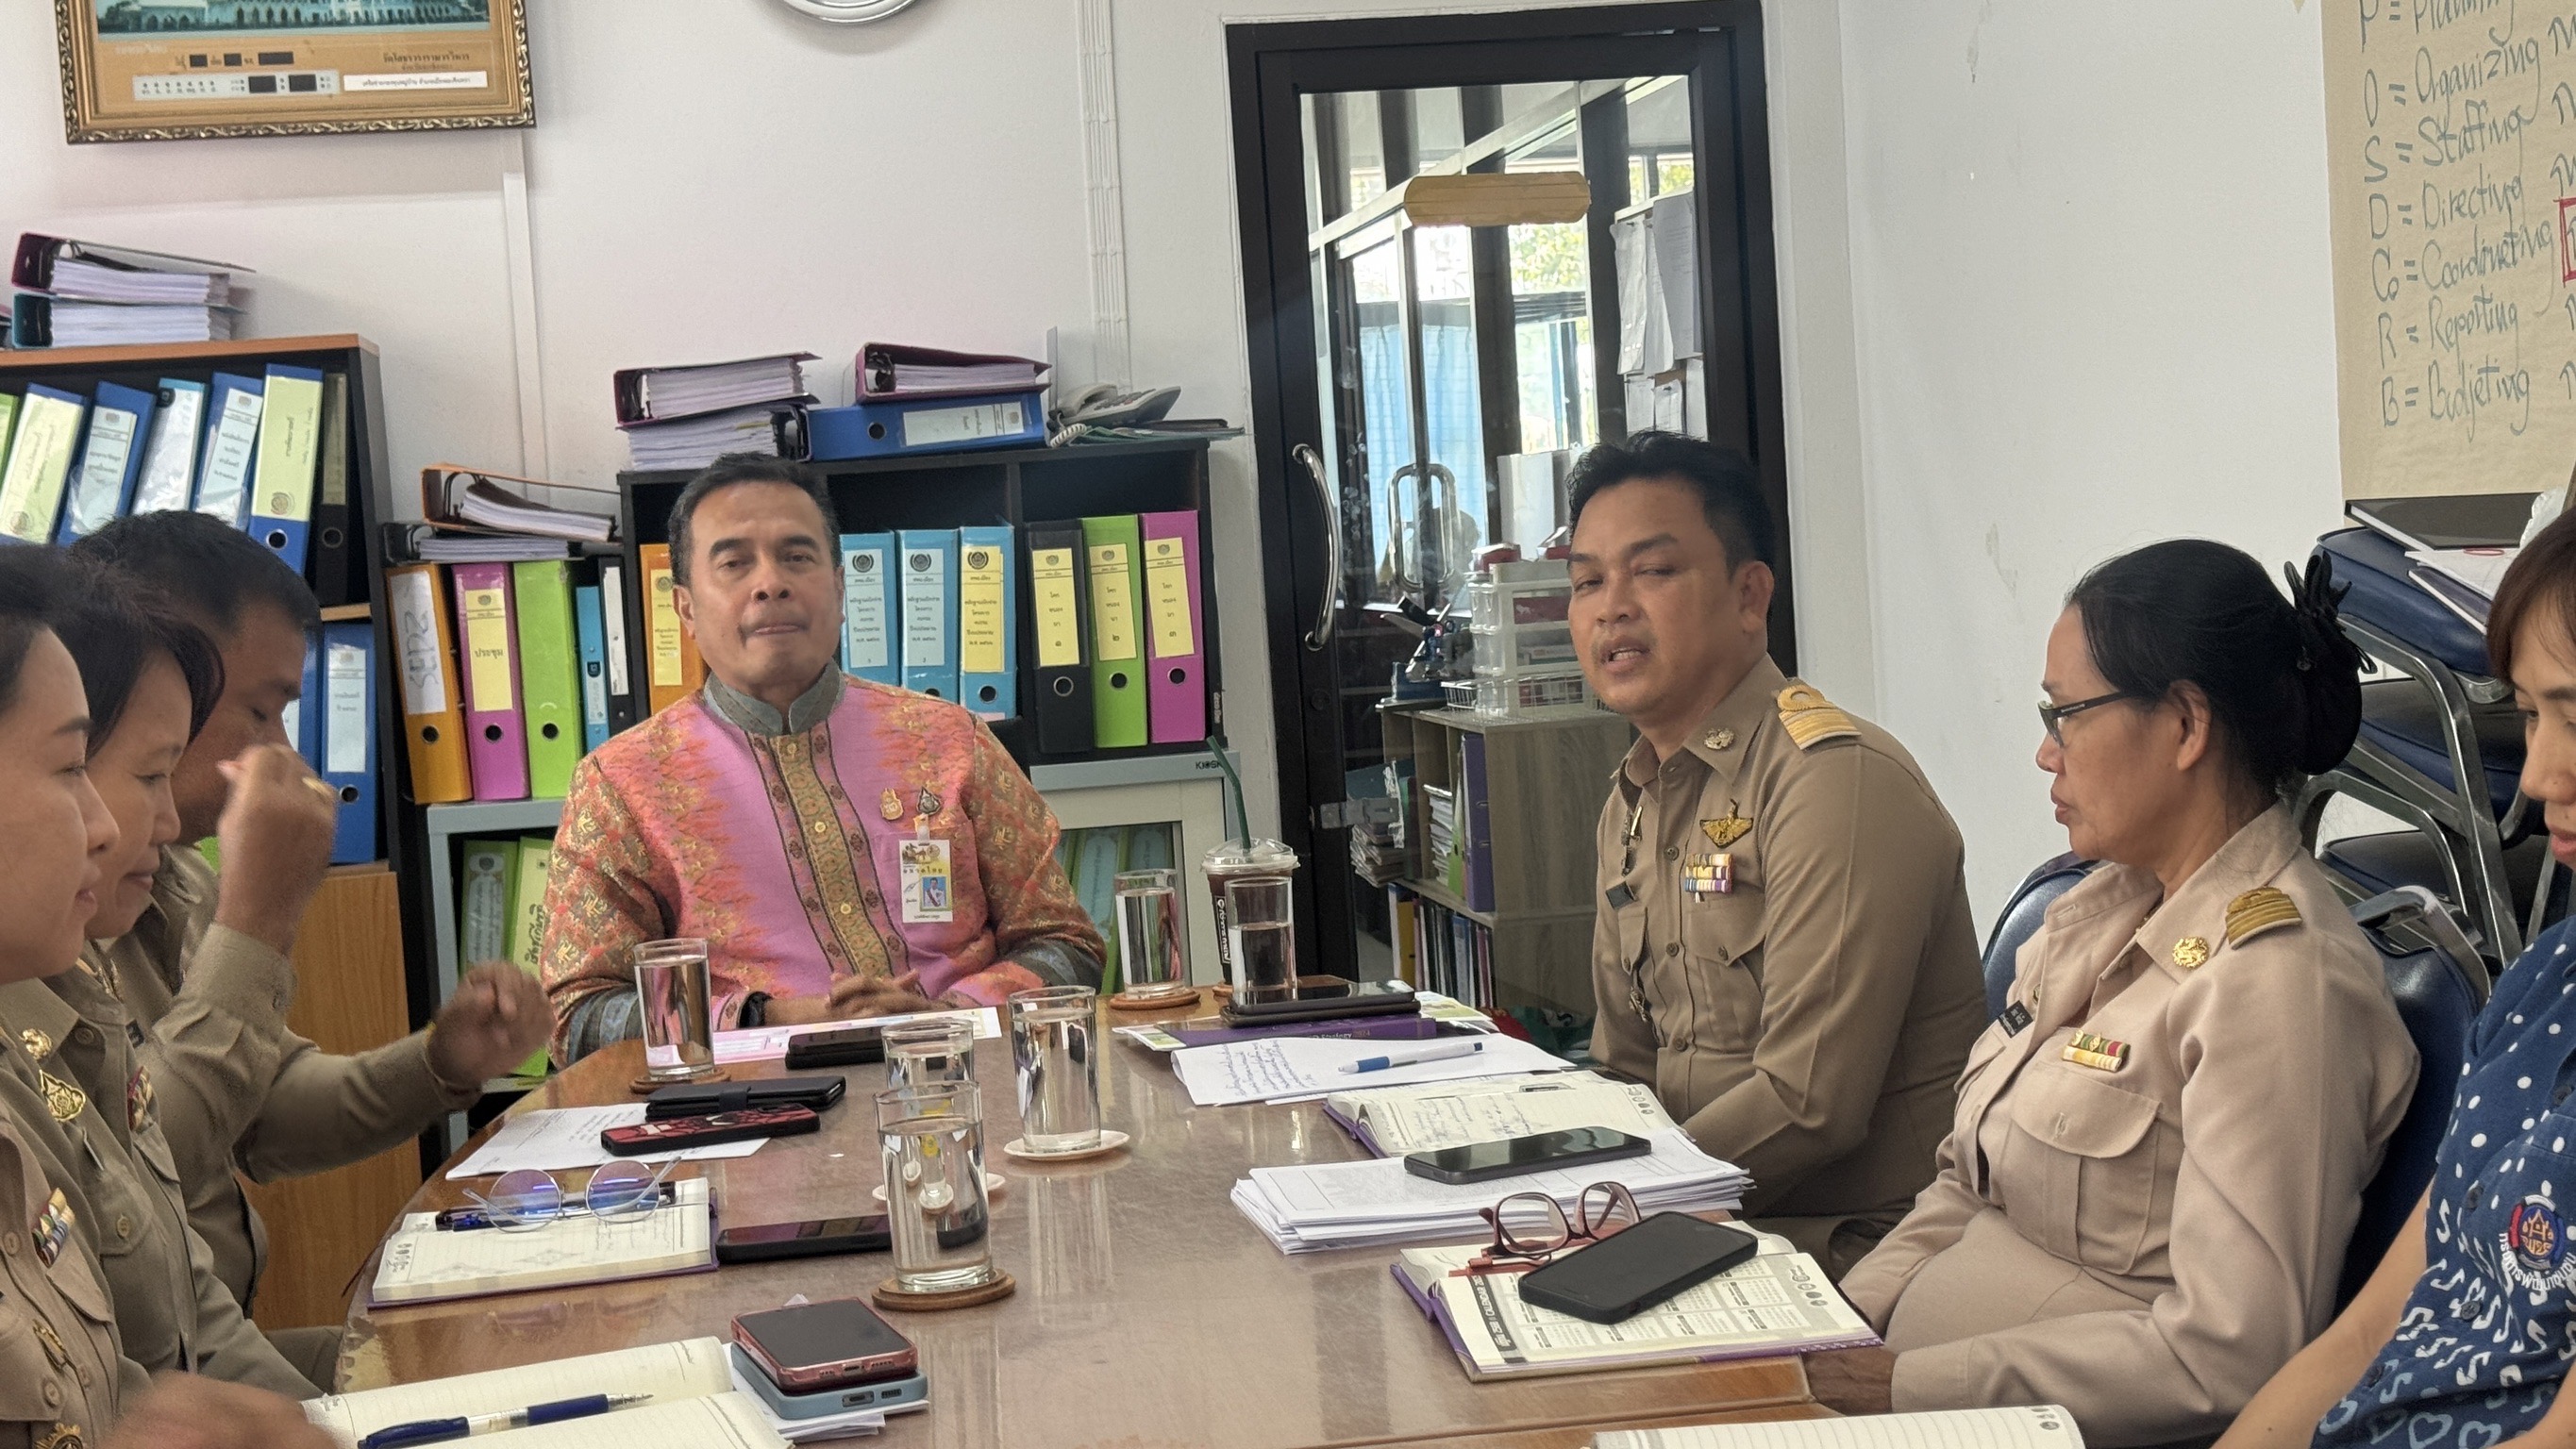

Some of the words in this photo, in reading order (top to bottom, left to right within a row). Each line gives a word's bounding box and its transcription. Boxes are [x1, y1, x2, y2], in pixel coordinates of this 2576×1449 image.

[2429, 284, 2518, 375] Reporting
[475, 648, 504, 659] ประชุม
